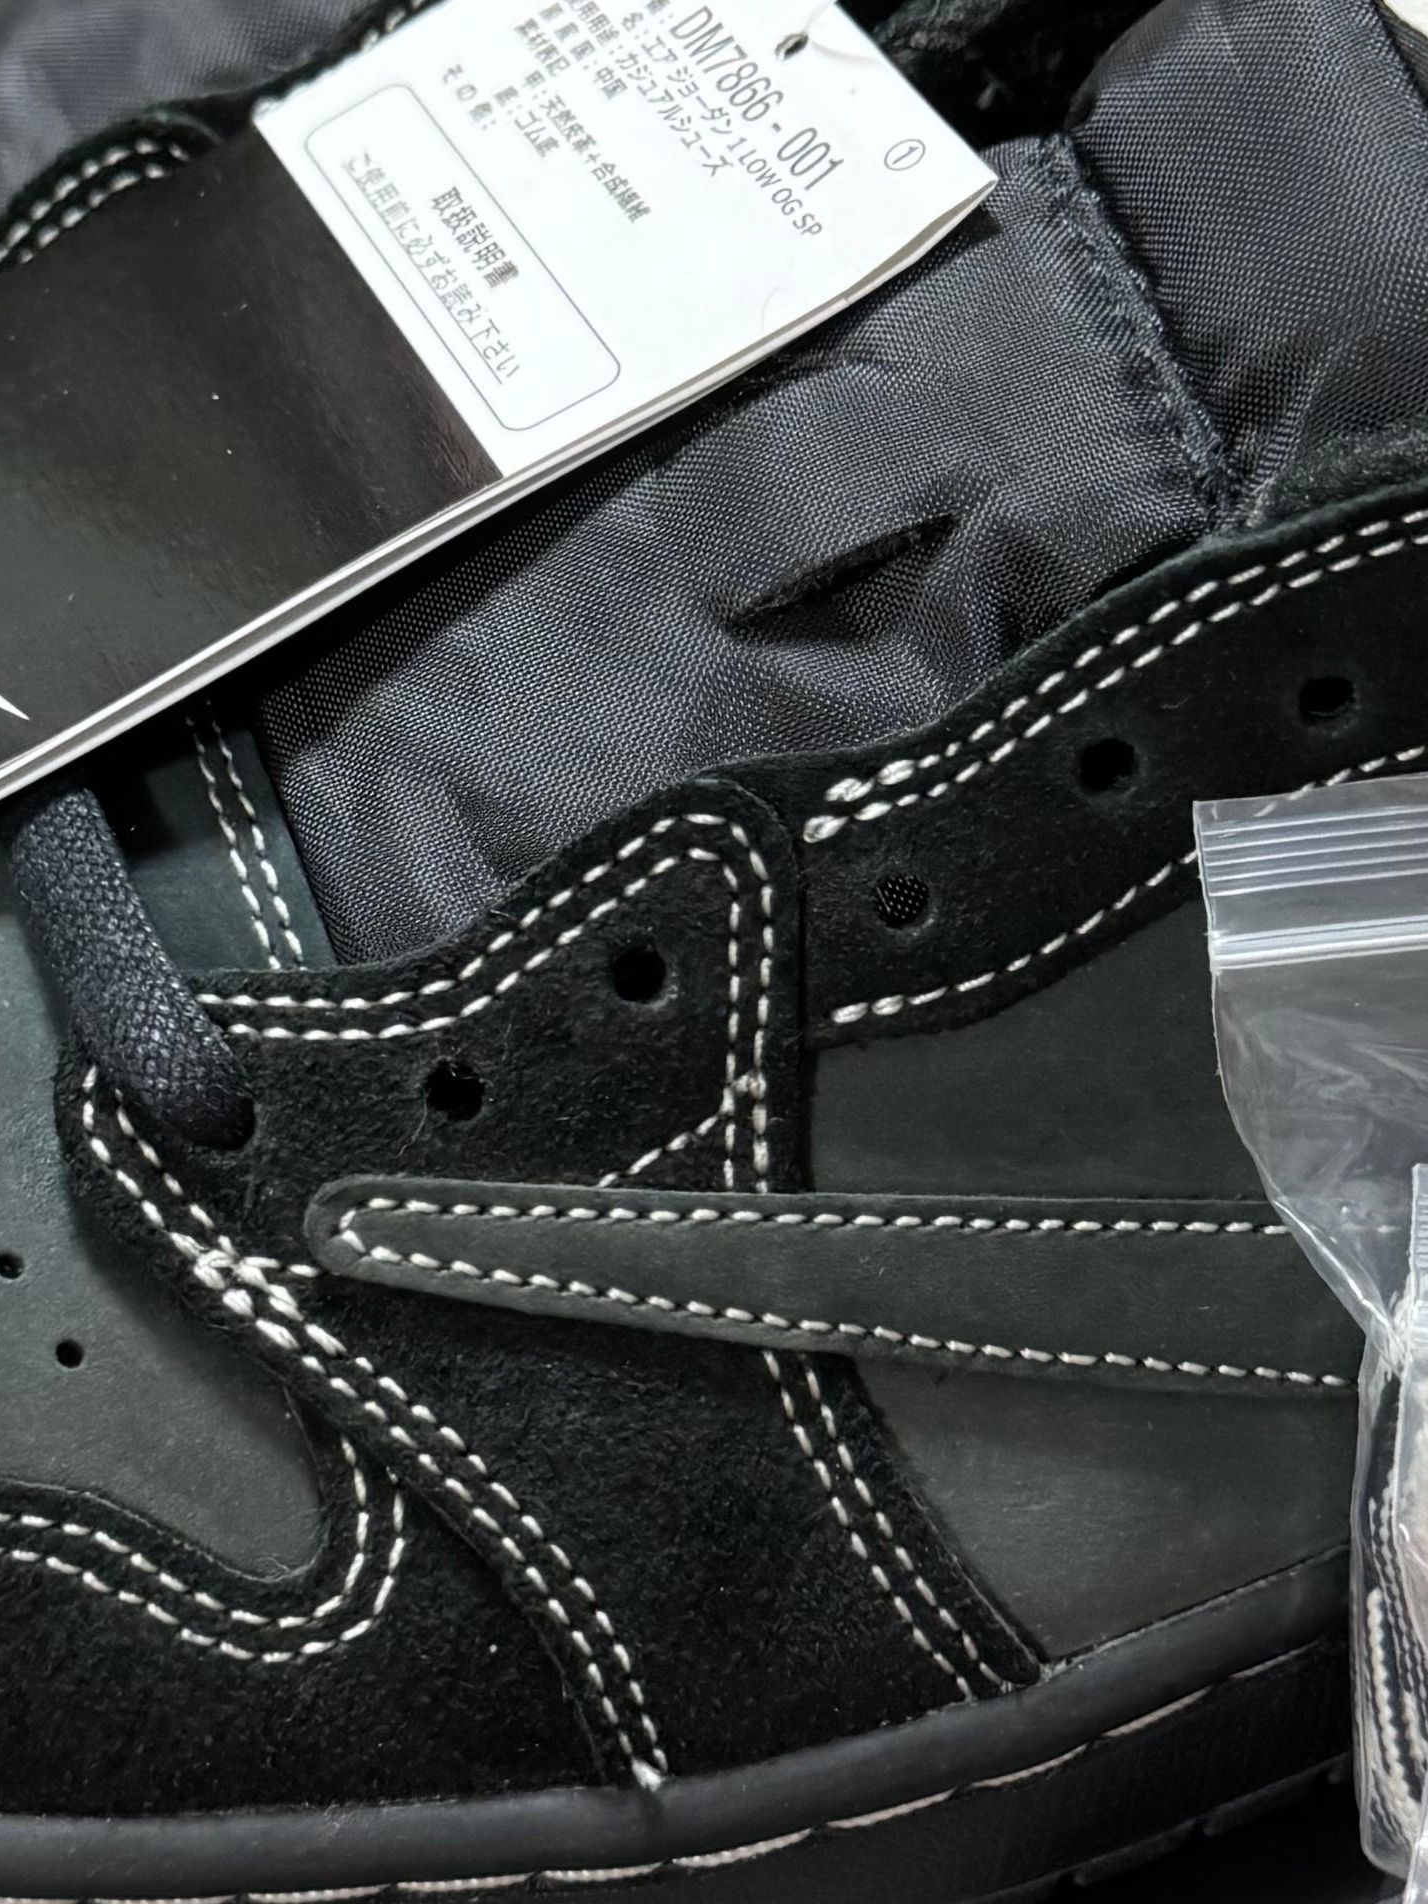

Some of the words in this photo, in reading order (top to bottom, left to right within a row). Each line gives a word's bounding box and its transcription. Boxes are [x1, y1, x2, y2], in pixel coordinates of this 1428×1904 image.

[430, 185, 520, 289] 取扱説明書
[737, 148, 783, 189] LOW
[771, 186, 803, 216] OG
[792, 212, 823, 236] SP
